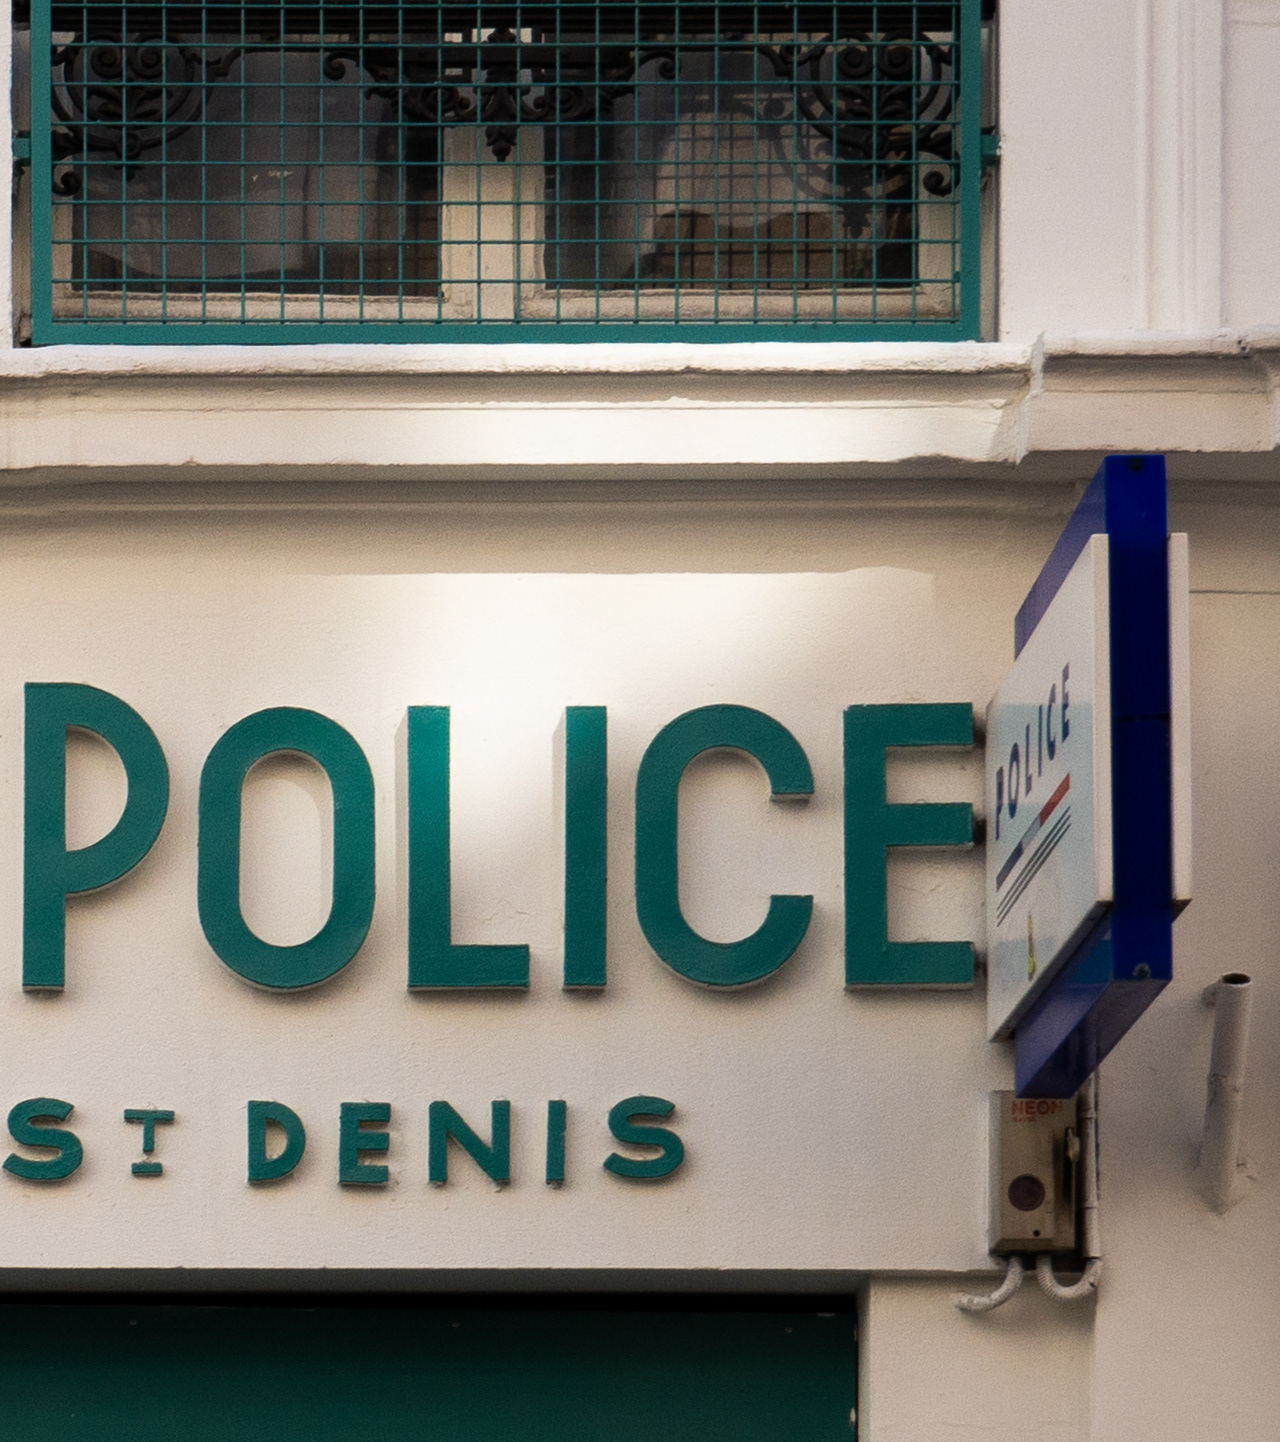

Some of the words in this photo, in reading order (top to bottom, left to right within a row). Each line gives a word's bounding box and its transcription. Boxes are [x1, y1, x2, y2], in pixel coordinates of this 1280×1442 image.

[22, 684, 976, 990] POLICE
[995, 661, 1071, 841] POLICE
[247, 1095, 684, 1185] DENIS
